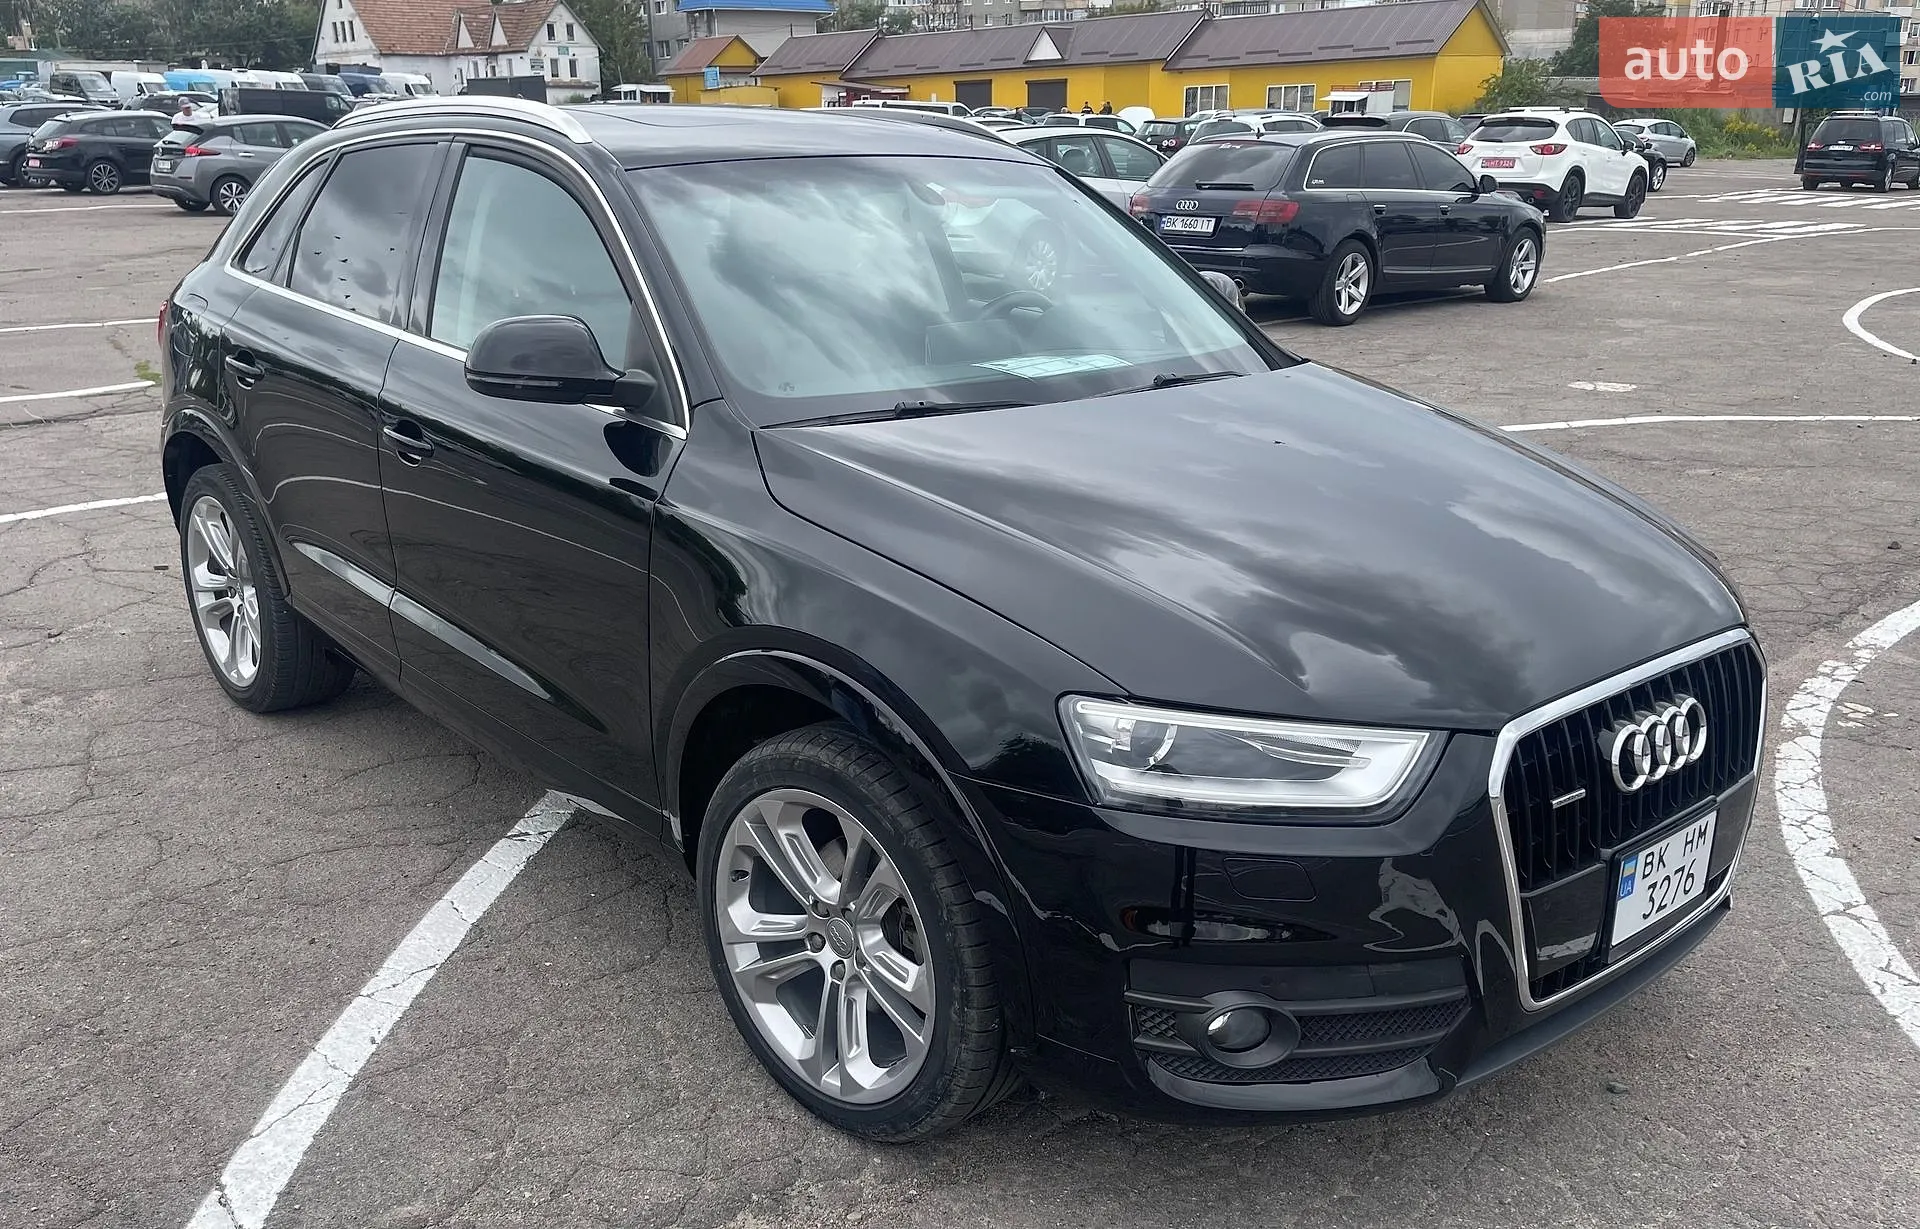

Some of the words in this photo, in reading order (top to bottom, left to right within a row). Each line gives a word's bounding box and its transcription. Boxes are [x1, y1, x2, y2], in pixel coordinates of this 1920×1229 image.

[1165, 217, 1177, 229] BK
[1179, 218, 1198, 229] 1660
[1200, 219, 1213, 230] IT
[1642, 842, 1670, 880] BK
[1682, 820, 1710, 856] HM
[1620, 879, 1633, 897] UA
[1641, 858, 1696, 920] 3276
